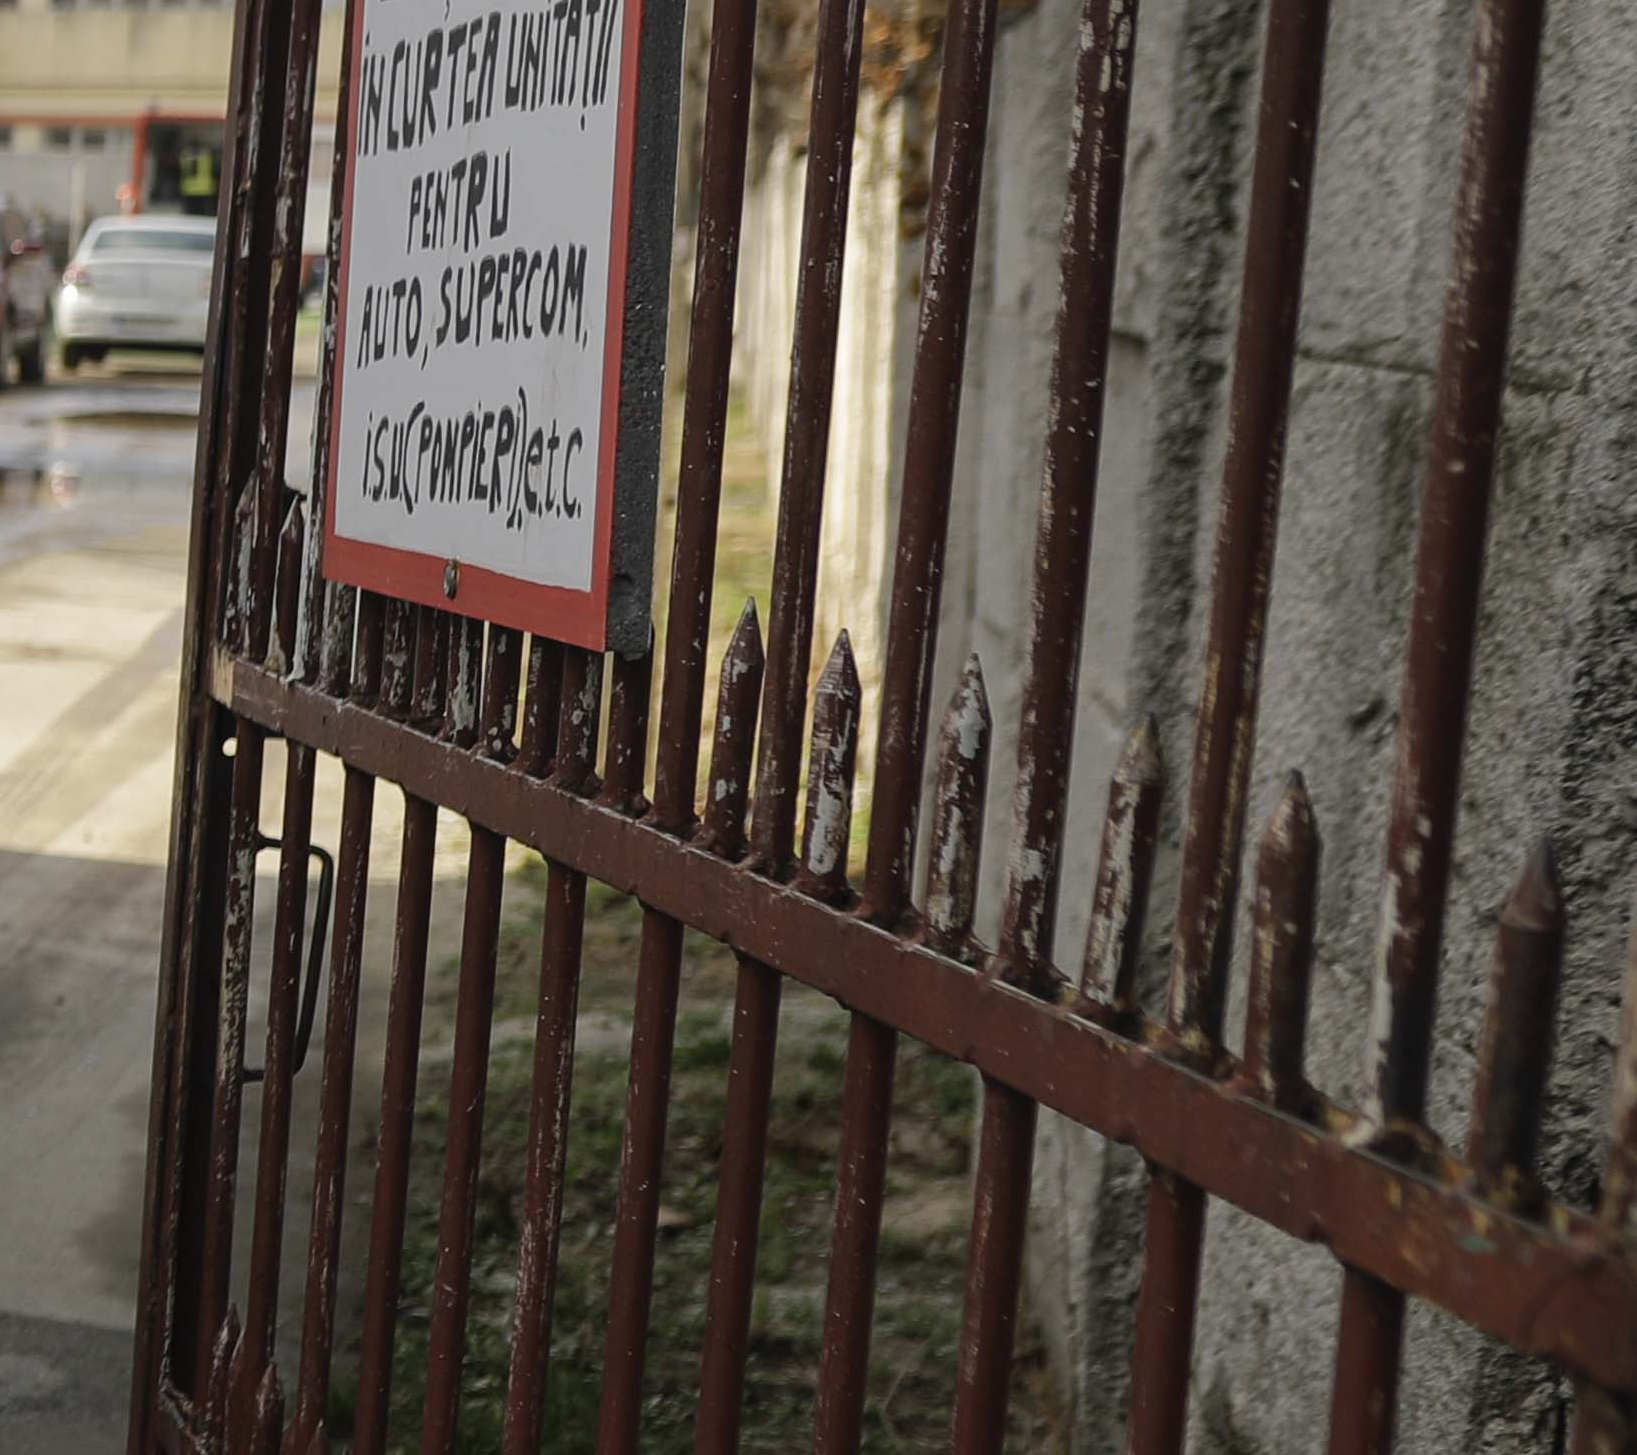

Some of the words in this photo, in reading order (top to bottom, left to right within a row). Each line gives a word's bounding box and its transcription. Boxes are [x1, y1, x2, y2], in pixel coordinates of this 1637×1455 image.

[387, 11, 501, 151] CURTEA
[407, 147, 513, 256] PENTRU
[357, 276, 429, 370] AUTO,
